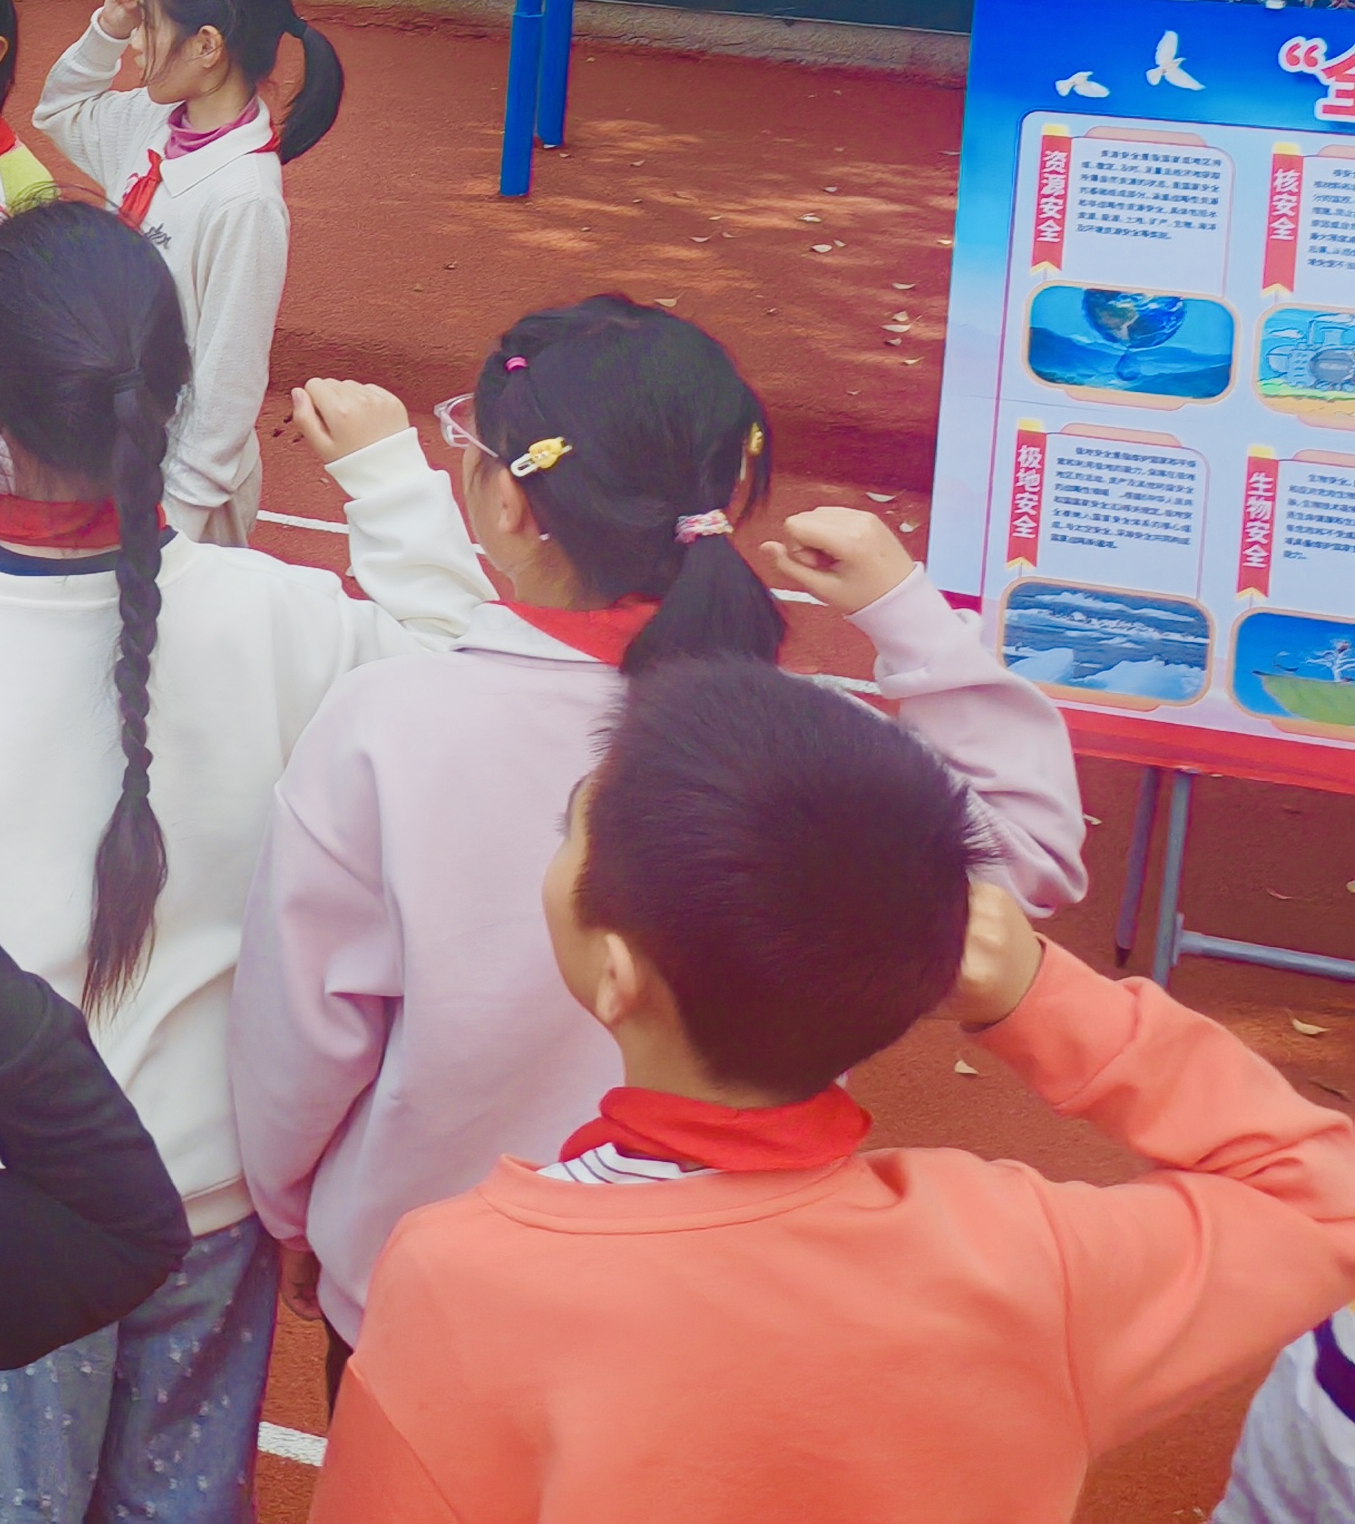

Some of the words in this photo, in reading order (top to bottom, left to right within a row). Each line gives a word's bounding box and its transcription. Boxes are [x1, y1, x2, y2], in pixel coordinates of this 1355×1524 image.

[1036, 150, 1069, 244] 资源安全
[1269, 168, 1301, 242] 核安全
[1011, 444, 1043, 540] 极地安全
[1242, 471, 1275, 569] 生物安全
